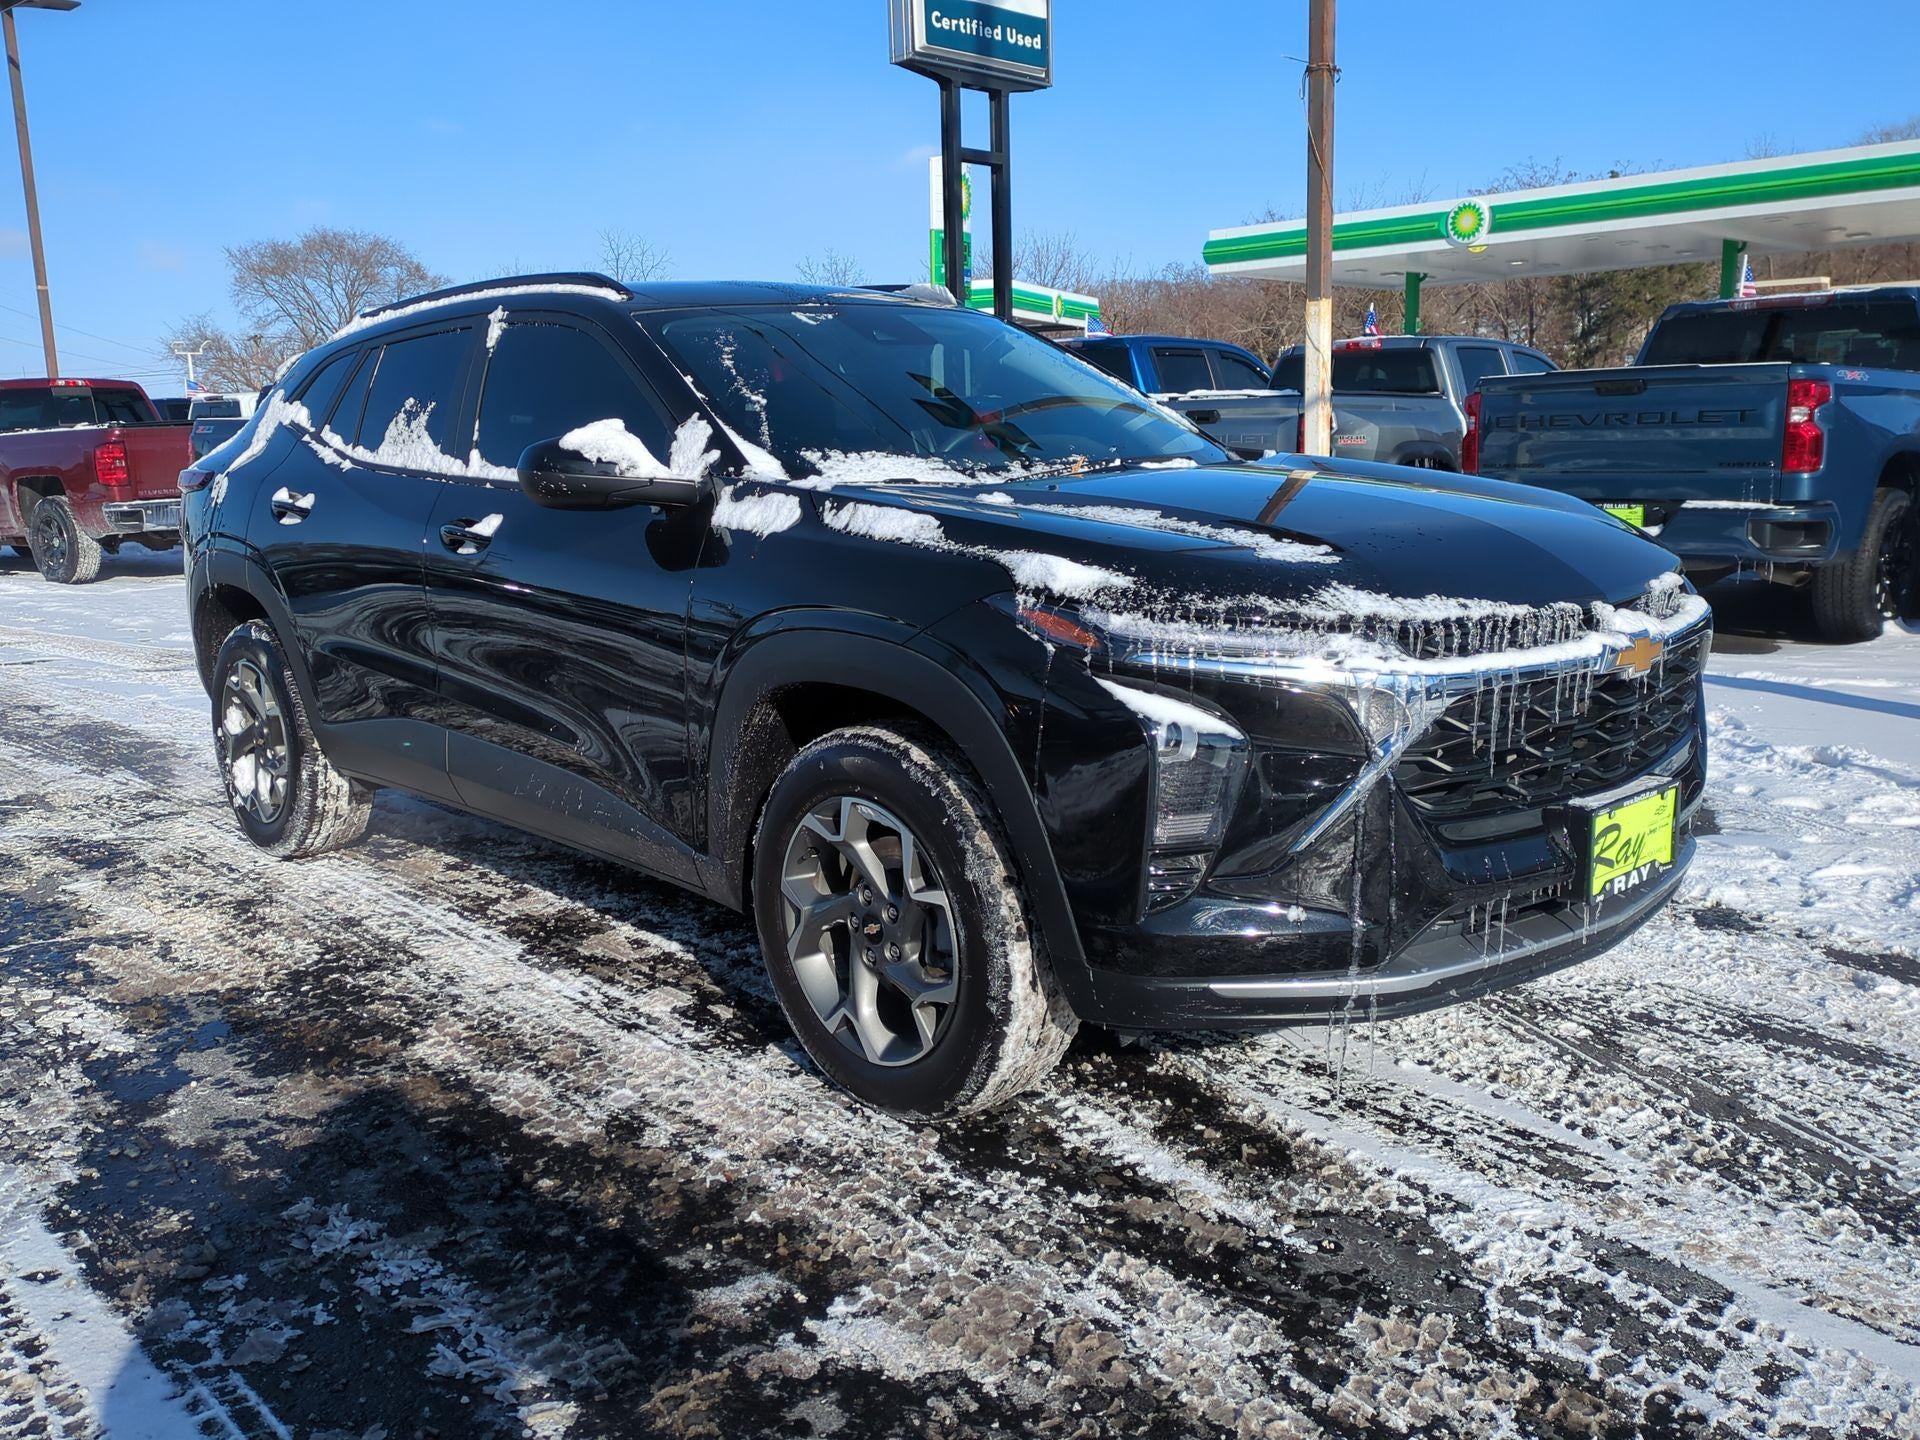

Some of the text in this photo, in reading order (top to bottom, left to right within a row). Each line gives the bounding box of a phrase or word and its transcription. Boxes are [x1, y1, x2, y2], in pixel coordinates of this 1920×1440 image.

[931, 10, 1042, 50] Certified Used
[1494, 408, 1759, 429] CHEVROLET
[1594, 822, 1646, 870] Ray
[1613, 863, 1651, 895] RAY
